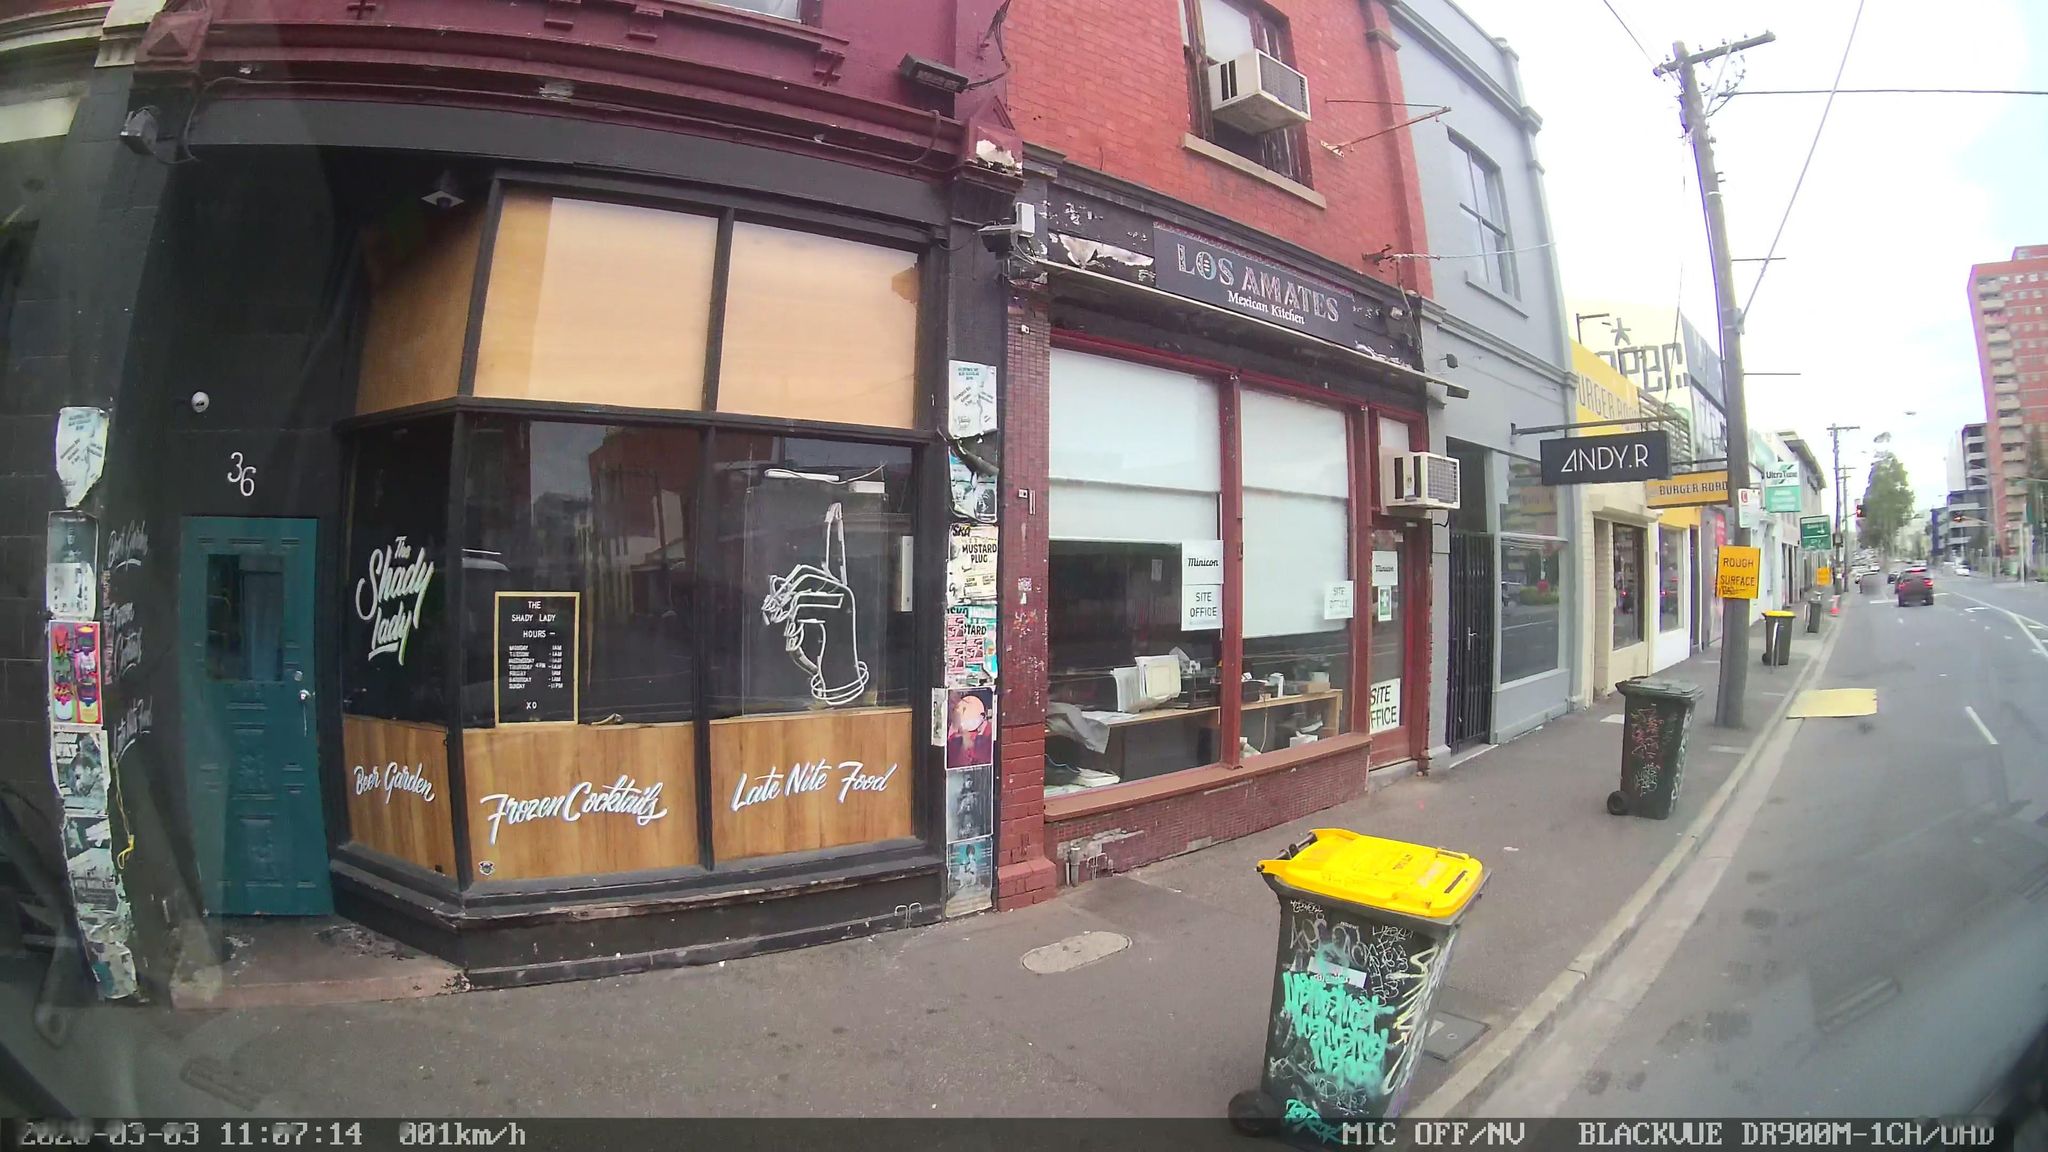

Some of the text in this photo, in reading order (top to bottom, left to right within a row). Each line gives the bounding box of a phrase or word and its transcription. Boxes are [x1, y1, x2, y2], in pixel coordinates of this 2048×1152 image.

[1176, 243, 1339, 322] LOS AMATES
[1227, 289, 1306, 325] Mexican Kitchen
[1560, 443, 1650, 473] ANDY.R
[227, 452, 257, 496] 36
[1765, 471, 1782, 479] Ultra
[1659, 483, 1699, 496] BURGER
[951, 523, 971, 538] SKA
[394, 536, 412, 559] The
[962, 543, 997, 555] MUSTARD
[971, 554, 988, 564] PLUG
[1188, 557, 1219, 567] Minicon
[1723, 557, 1754, 568] ROUGH
[355, 545, 435, 629] Shady
[1720, 574, 1755, 587] SURFACE
[1195, 592, 1212, 602] SITE
[528, 601, 541, 609] THE
[1189, 606, 1218, 617] OFFICE
[511, 614, 556, 622] SHADY LADY
[523, 630, 546, 638] HOURS
[1370, 685, 1391, 705] SITE
[1370, 706, 1397, 729] FFICE
[353, 761, 436, 804] Beer Garden
[729, 757, 898, 812] Late Nite Food
[480, 774, 668, 846] Frozen Cocktails
